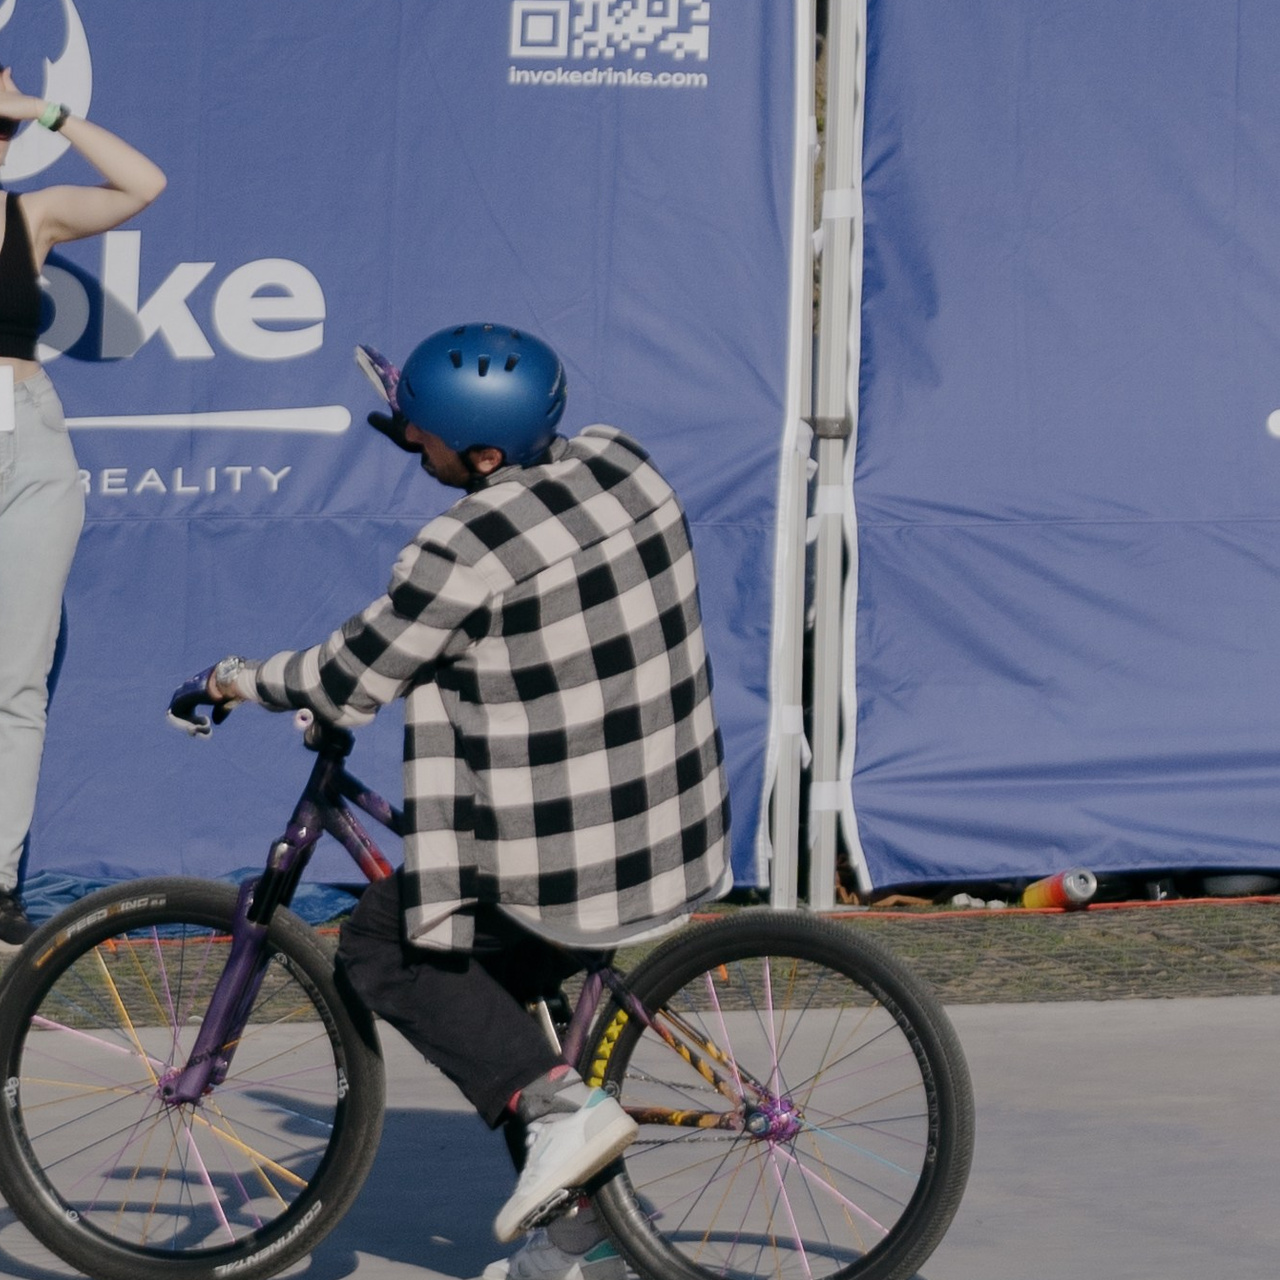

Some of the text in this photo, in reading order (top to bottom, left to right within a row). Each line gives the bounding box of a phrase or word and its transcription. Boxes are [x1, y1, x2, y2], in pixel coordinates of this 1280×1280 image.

[508, 66, 709, 88] invokedrinks.com
[589, 1008, 629, 1088] AXXI
[214, 1199, 322, 1277] CONTINENTAL
